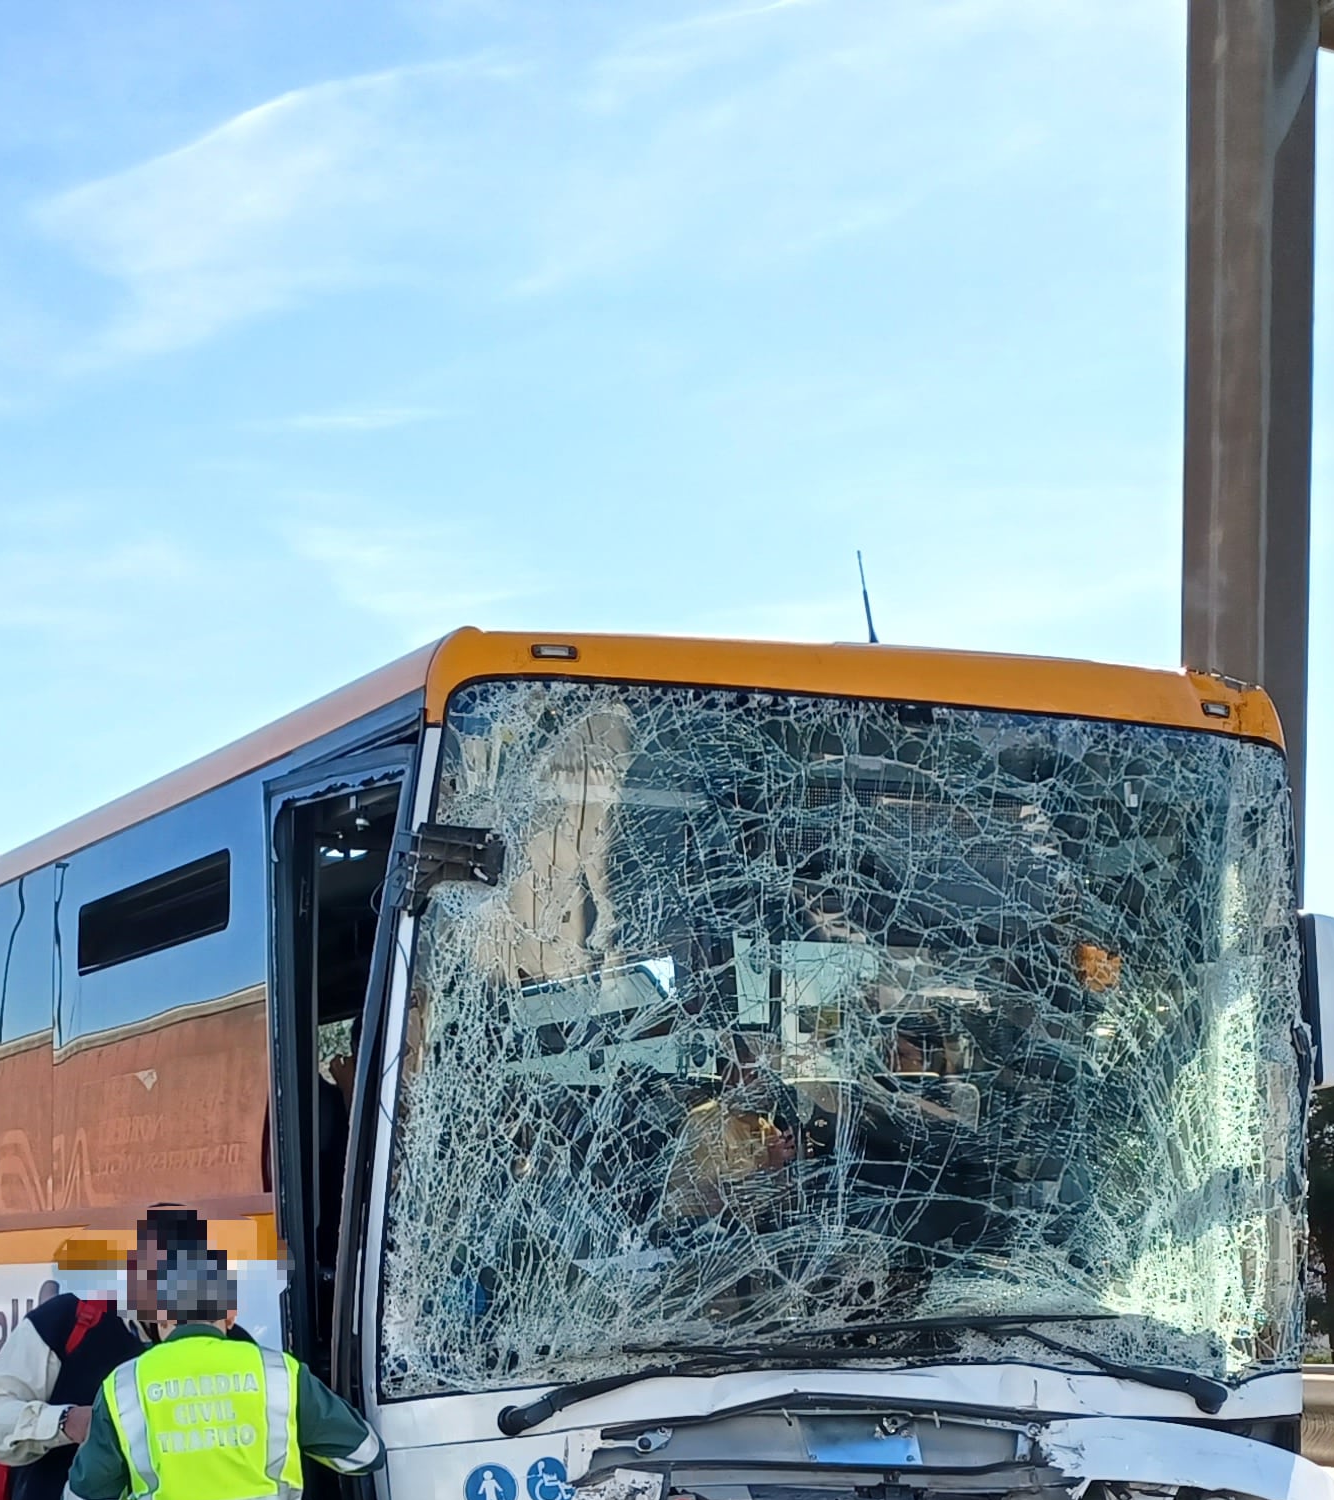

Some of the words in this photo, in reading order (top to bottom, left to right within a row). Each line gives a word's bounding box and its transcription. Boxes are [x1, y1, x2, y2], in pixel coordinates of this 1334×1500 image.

[147, 1372, 259, 1402] GUARDIA
[174, 1400, 237, 1425] CIVIL
[157, 1425, 256, 1453] TRAFICO
